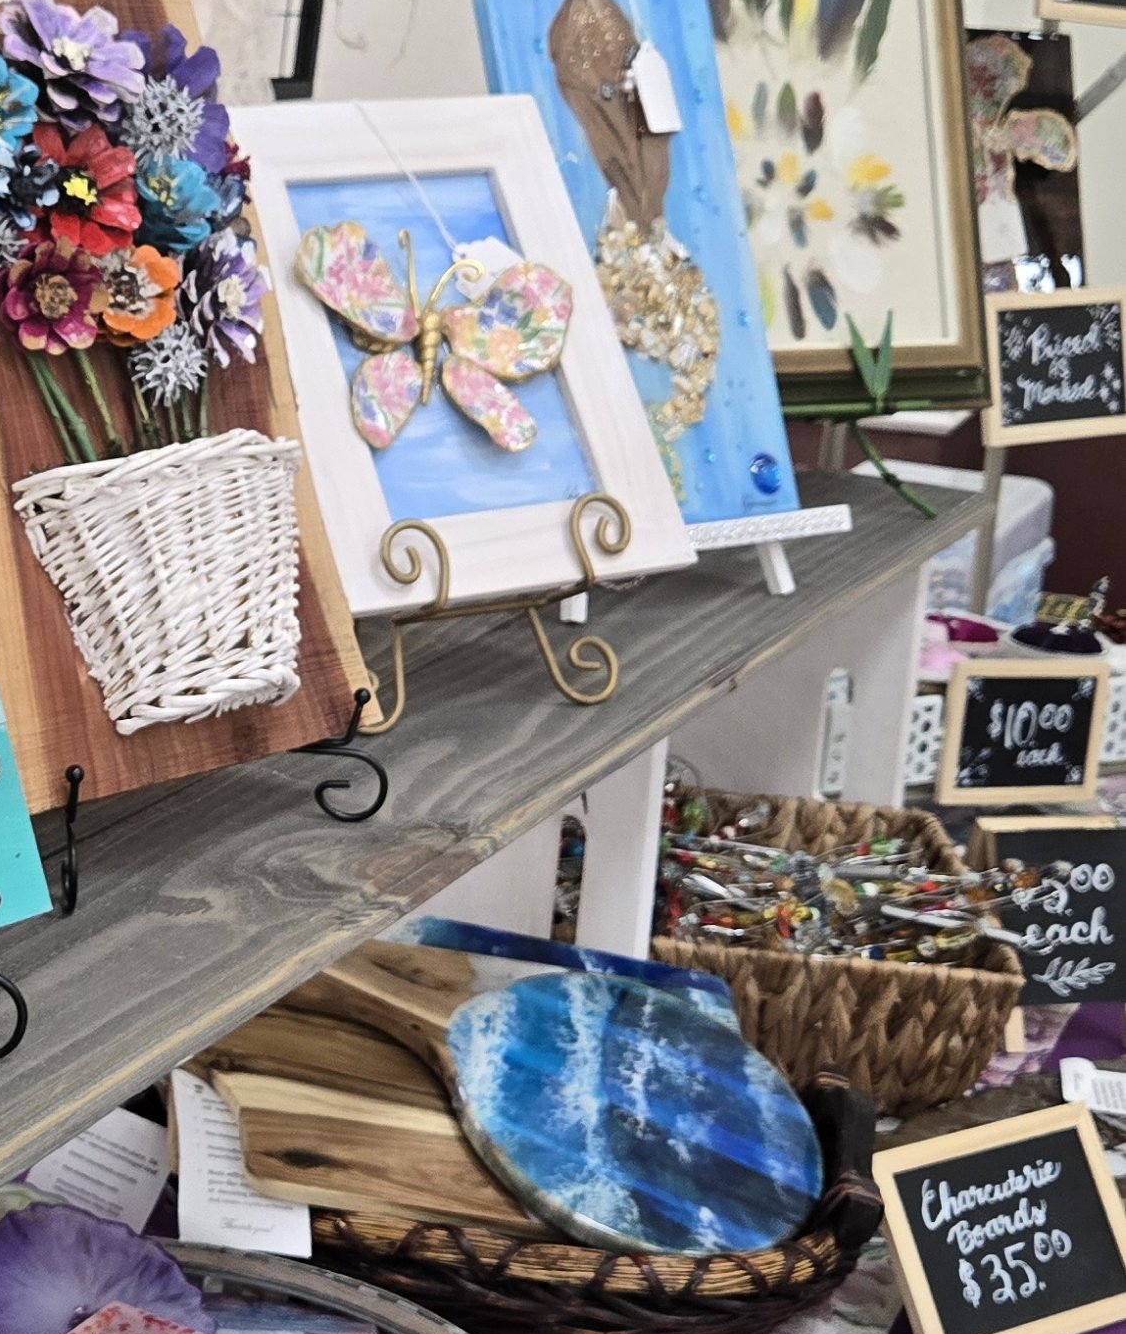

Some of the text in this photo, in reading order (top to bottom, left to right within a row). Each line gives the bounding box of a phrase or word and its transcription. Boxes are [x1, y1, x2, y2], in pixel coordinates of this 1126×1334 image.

[1026, 906, 1114, 946] each
[921, 1159, 1062, 1231] Charcuterie
[947, 1197, 1048, 1255] Boards
